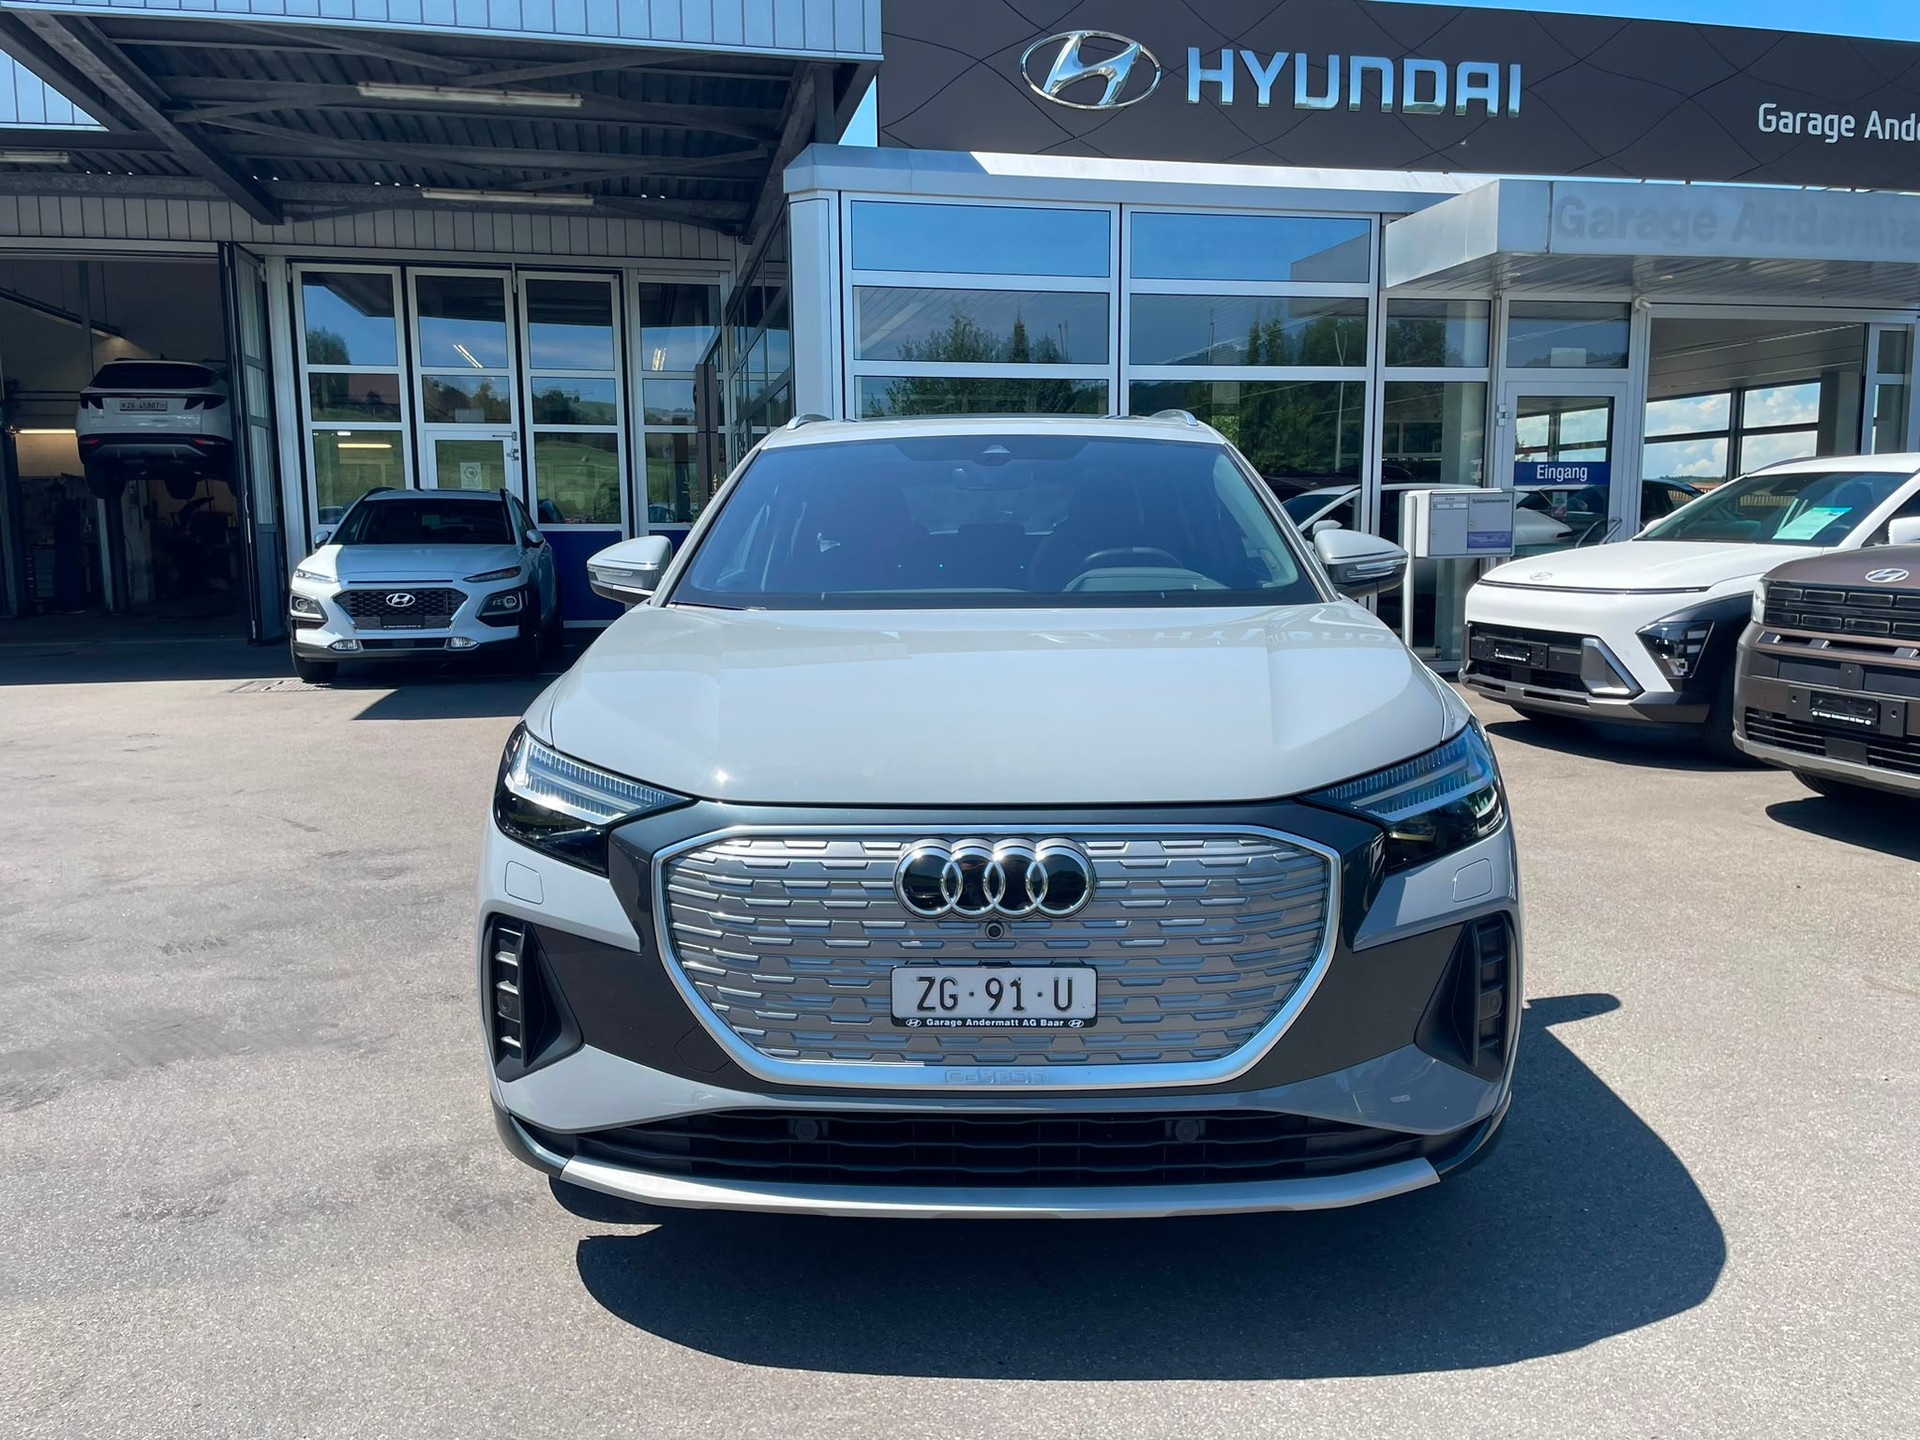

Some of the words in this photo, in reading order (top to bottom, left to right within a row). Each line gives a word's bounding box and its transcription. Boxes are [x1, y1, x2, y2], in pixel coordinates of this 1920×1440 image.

[1187, 47, 1521, 118] HYUNDAI
[1758, 102, 1856, 143] Garage
[1863, 110, 1920, 142] And
[1555, 196, 1718, 248] Garage
[1536, 464, 1588, 482] Eingang
[926, 1018, 962, 1027] Garage
[965, 1018, 1019, 1027] Andermatt
[1022, 1018, 1037, 1027] AG
[1040, 1018, 1064, 1027] Baar
